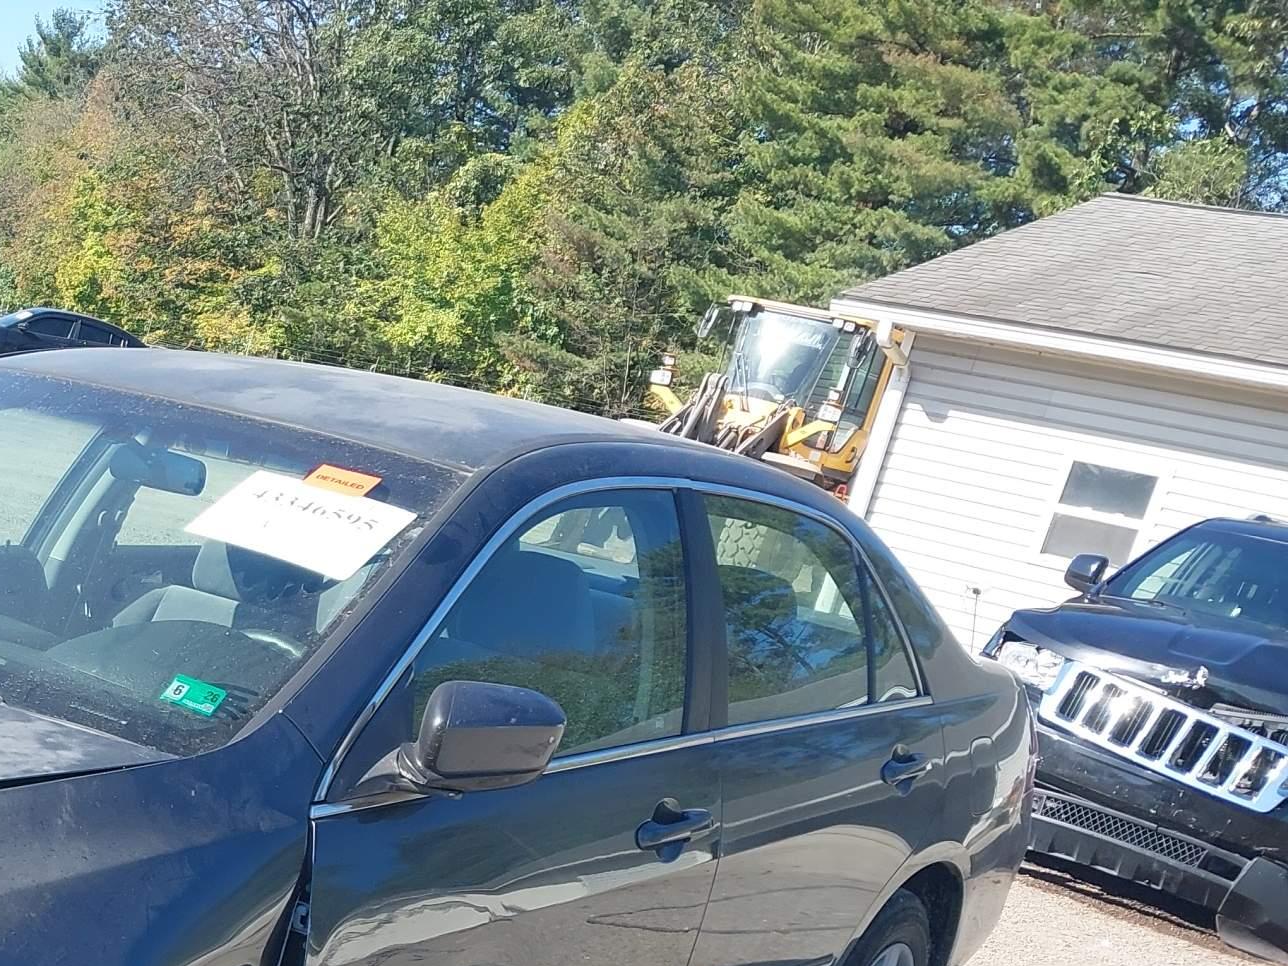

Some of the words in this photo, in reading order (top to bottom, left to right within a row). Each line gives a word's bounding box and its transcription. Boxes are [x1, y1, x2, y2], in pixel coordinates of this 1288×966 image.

[316, 474, 365, 490] DETAILED
[173, 685, 185, 696] 6
[204, 691, 220, 703] 26
